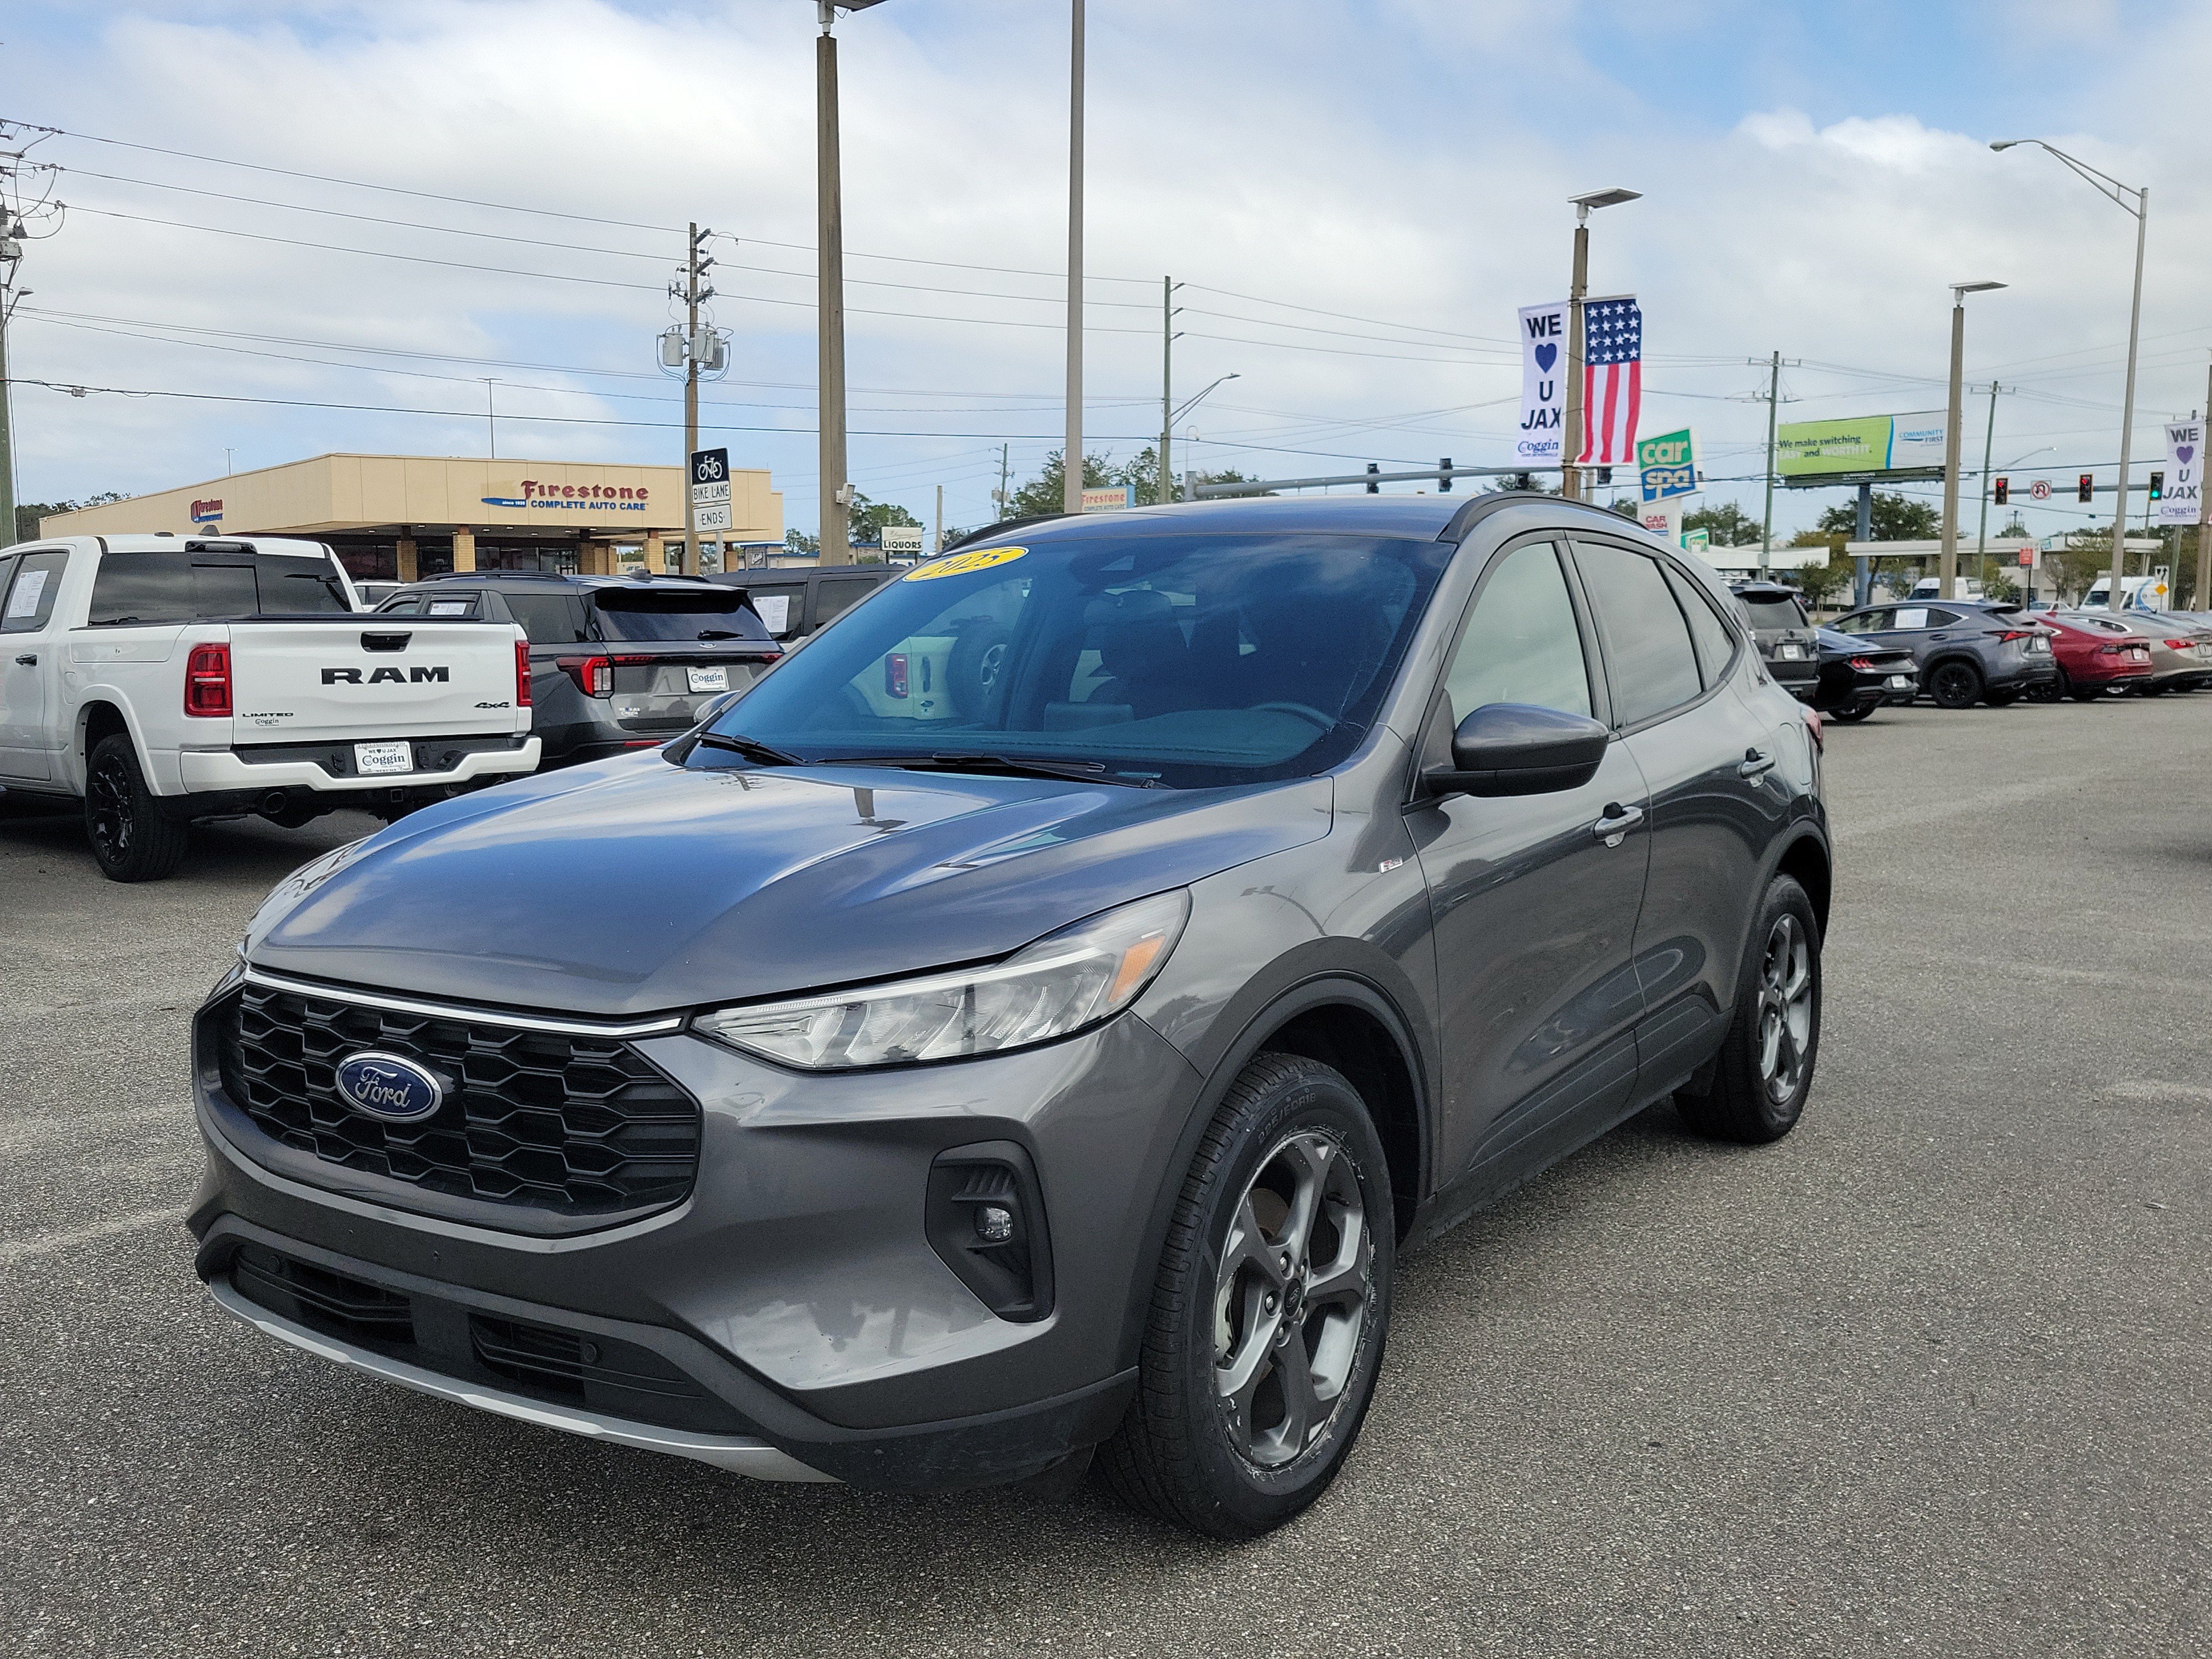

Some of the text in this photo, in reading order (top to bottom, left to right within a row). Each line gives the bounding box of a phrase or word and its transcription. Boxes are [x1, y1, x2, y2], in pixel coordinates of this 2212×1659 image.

[1526, 314, 1562, 338] WE
[1539, 381, 1554, 402] U
[1521, 407, 1561, 430] JAX
[1899, 429, 1943, 438] COMMUNITY
[2170, 428, 2198, 443] WE
[1517, 439, 1559, 453] Coggin
[1795, 438, 1818, 447] make
[1819, 435, 1861, 446] switching
[1641, 441, 1689, 464] car
[1803, 448, 1820, 458] and
[2179, 469, 2190, 482] U
[1645, 470, 1691, 496] spa
[521, 481, 649, 500] Firestone
[693, 484, 730, 500] BIKE LANE
[2163, 486, 2198, 499] JAX
[531, 500, 646, 511] COMPLETE AUTO CARE
[1082, 494, 1125, 504] Firestone
[2161, 506, 2196, 516] Coggin
[701, 511, 724, 526] ENDS
[884, 540, 922, 549] LIQUORS
[321, 666, 449, 685] RAM
[691, 673, 724, 684] Coggin
[362, 754, 405, 766] Coggin
[355, 1066, 411, 1108] Ford
